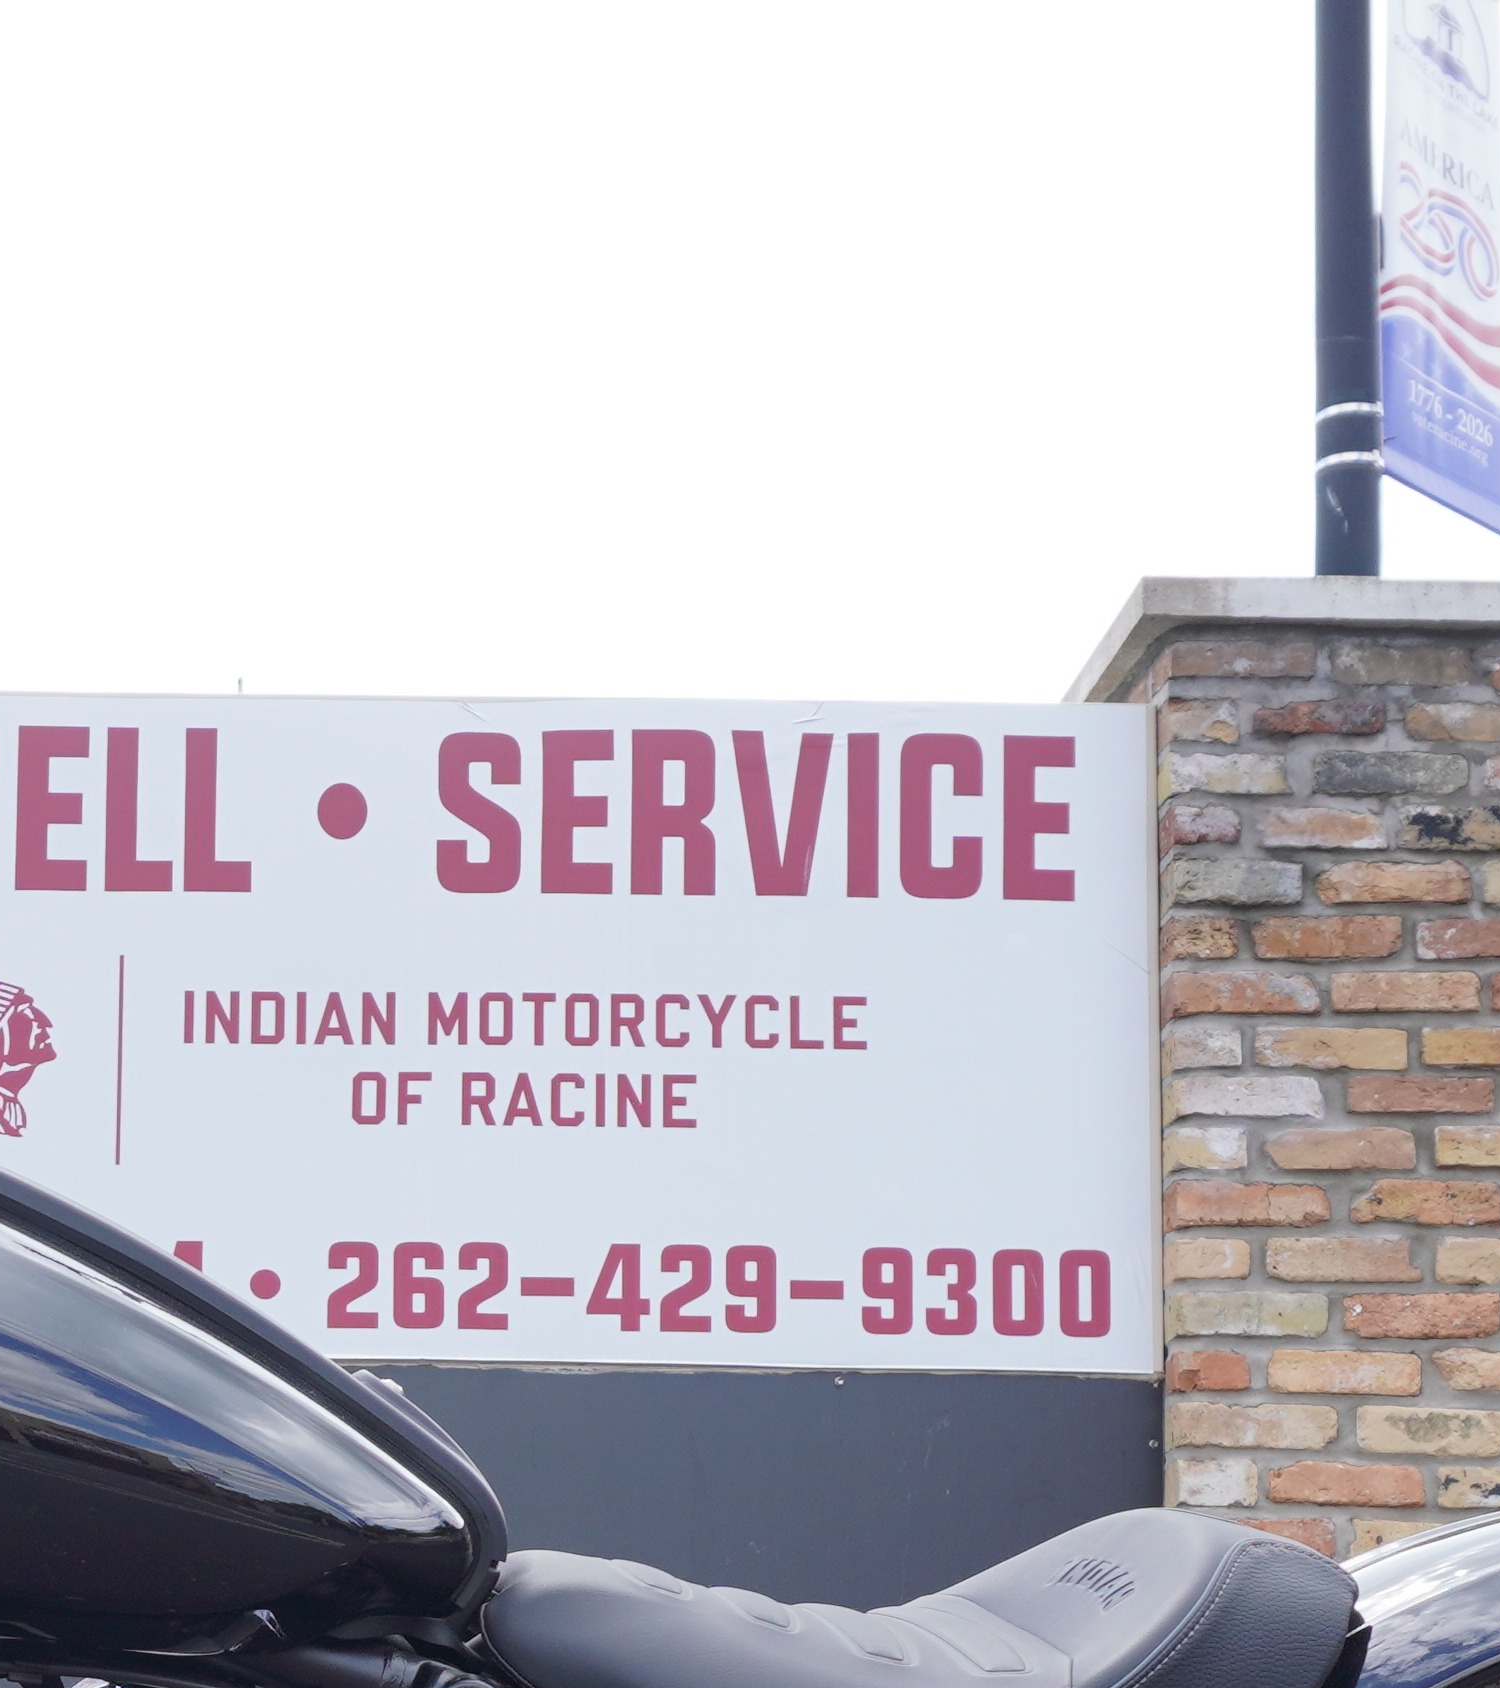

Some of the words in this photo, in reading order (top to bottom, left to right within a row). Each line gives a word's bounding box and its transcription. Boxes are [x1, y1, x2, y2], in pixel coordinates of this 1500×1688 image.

[1400, 115, 1496, 211] AMERICA
[1408, 379, 1443, 419] 1776
[1456, 407, 1494, 447] 2026
[434, 728, 1077, 902] SERVICE
[182, 989, 398, 1046] INDIAN
[427, 990, 869, 1051] MOTORCYCLE
[350, 1070, 434, 1127] OF
[460, 1072, 698, 1129] RACINE
[326, 1240, 1112, 1338] 262-429-9300
